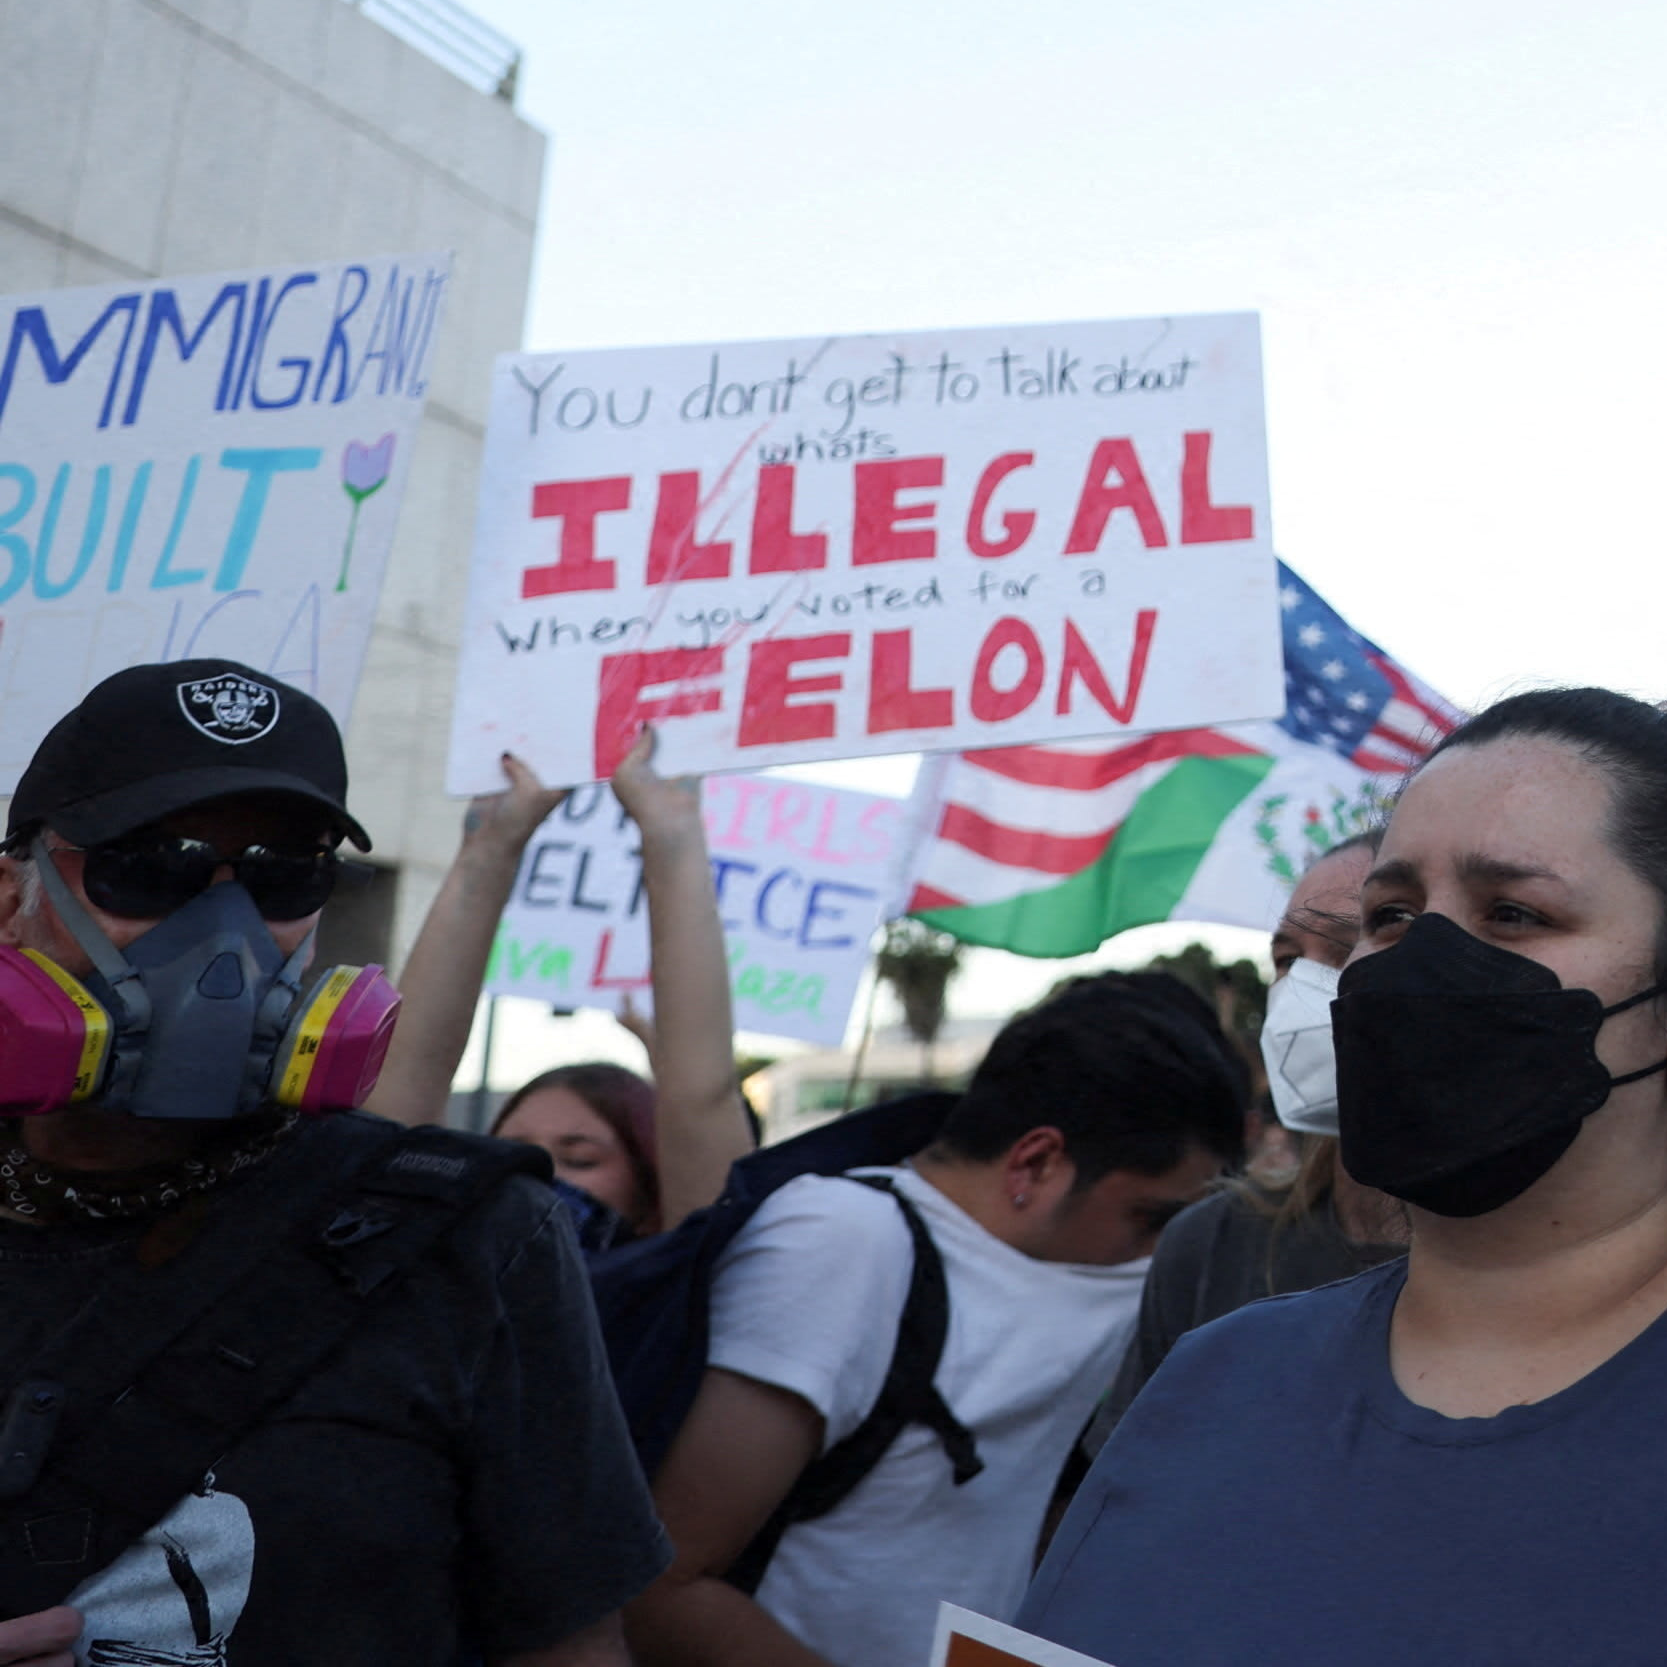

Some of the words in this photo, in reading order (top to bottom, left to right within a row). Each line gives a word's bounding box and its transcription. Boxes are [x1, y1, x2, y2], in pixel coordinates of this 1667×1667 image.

[824, 349, 917, 438] get
[929, 350, 980, 405] to
[1093, 355, 1200, 393] about
[521, 429, 1255, 600] ILLEGAL
[676, 600, 772, 652] you
[798, 575, 943, 617] voted
[969, 570, 1041, 604] for
[1078, 568, 1107, 596] a
[594, 608, 1159, 782] FELON
[704, 776, 902, 866] IRLS
[515, 840, 645, 919] ELT
[711, 856, 877, 948] ICE
[728, 937, 830, 1024] aza
